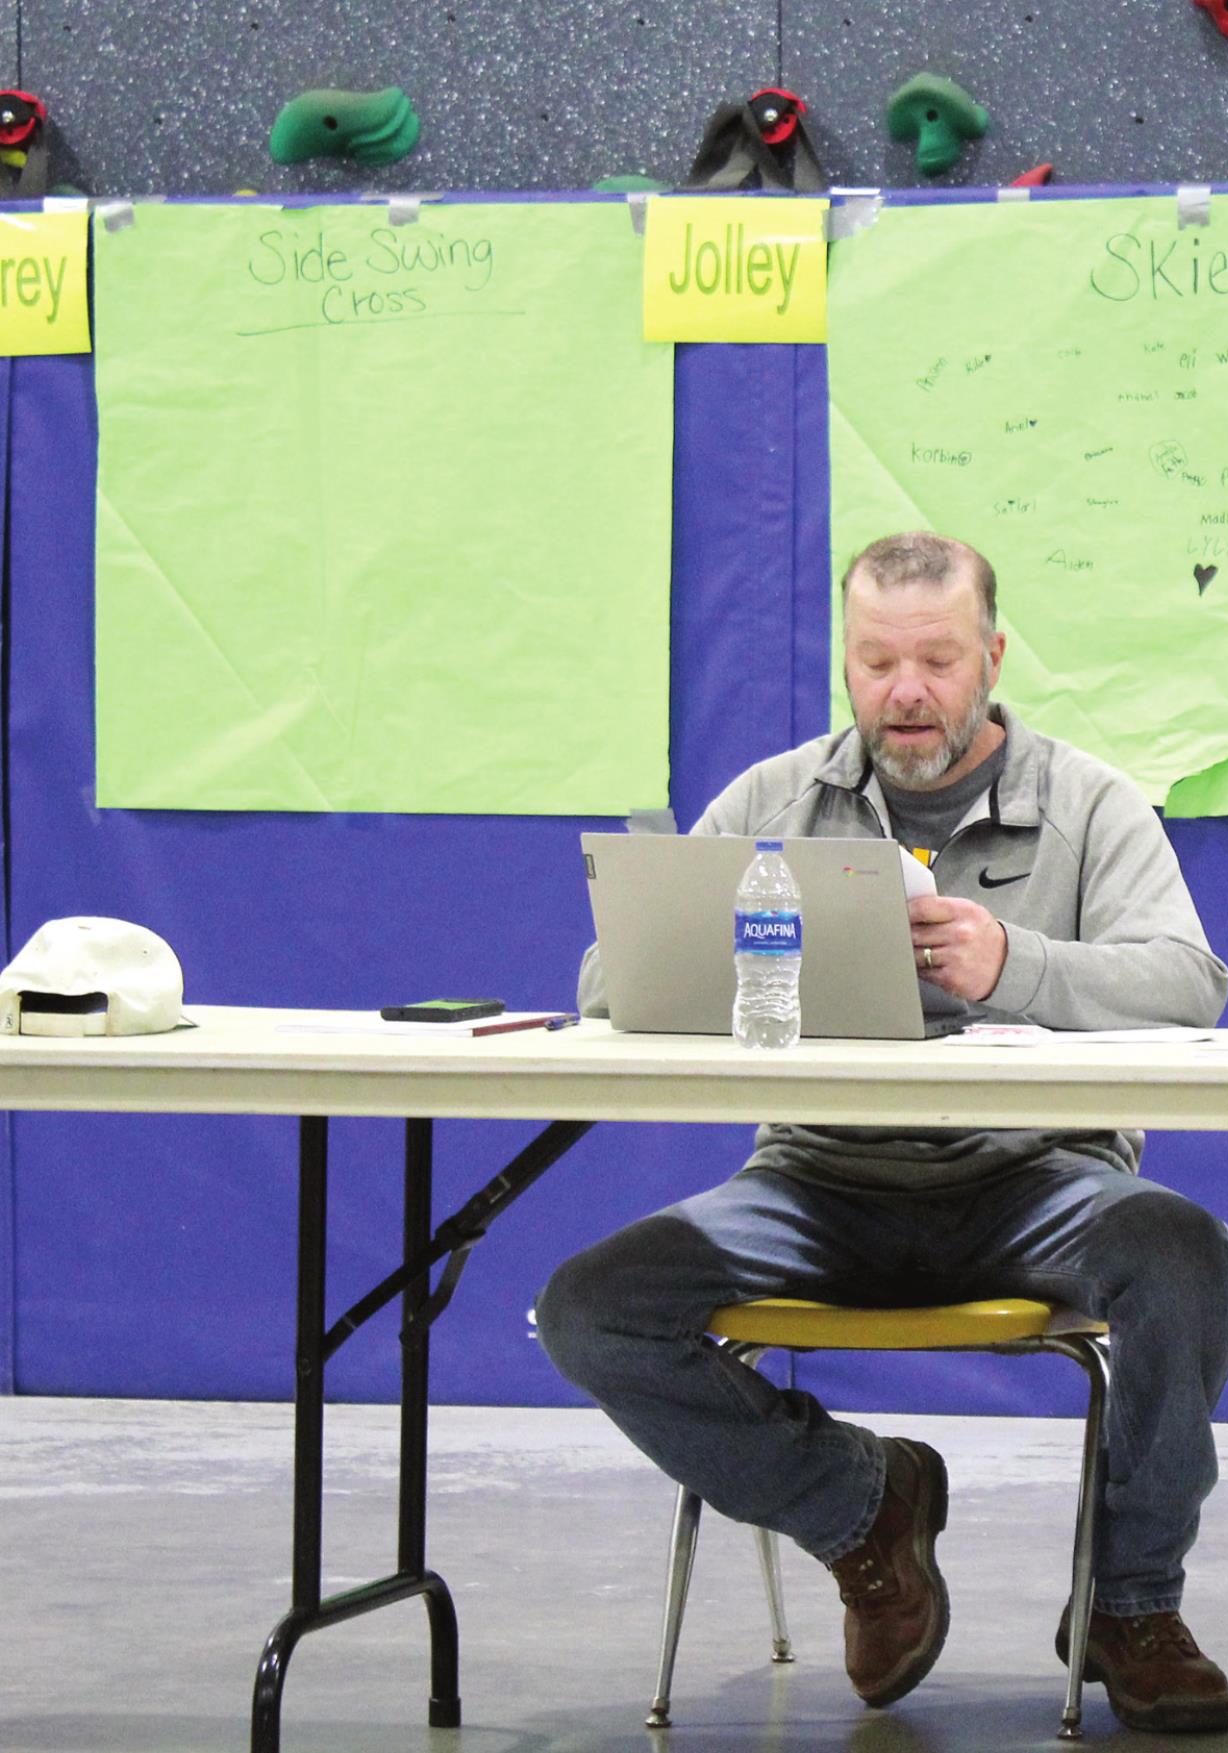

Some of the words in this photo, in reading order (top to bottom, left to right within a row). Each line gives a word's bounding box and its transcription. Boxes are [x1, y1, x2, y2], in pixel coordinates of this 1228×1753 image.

[248, 229, 353, 286] Side
[365, 227, 494, 292] Swing
[669, 222, 801, 316] Jolley
[321, 285, 427, 325] Cross
[743, 921, 797, 940] AQUAFINA
